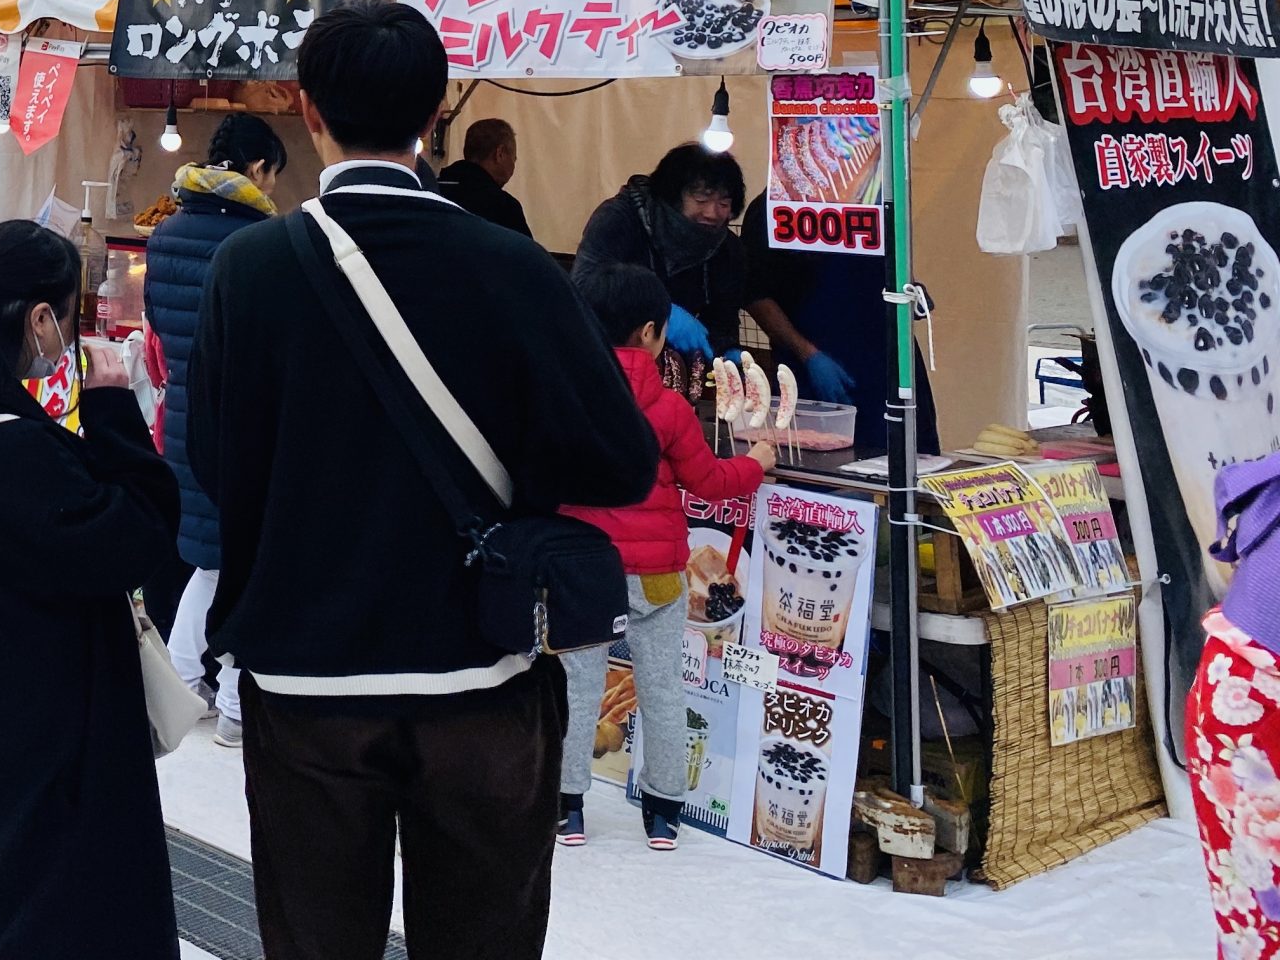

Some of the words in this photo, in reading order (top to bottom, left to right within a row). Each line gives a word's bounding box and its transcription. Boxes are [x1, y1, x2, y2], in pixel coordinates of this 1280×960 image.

[438, 0, 686, 70] ミルクティー
[762, 21, 809, 36] タピオカ
[789, 53, 824, 65] 500円
[37, 63, 61, 124] ペイペイ
[771, 74, 876, 102] 香蕉巧克力
[1062, 44, 1256, 118] 台湾直輸入
[772, 101, 818, 115] Banana
[820, 99, 879, 115] chocolate
[1096, 133, 1255, 190] 自家製スイーツ
[773, 206, 880, 248] 300円
[767, 493, 865, 536] 台湾直輸入
[761, 631, 854, 669] 究極のタピオカ
[779, 656, 830, 681] スイーツ
[766, 691, 831, 722] タピオカ
[766, 713, 829, 745] ドリンク
